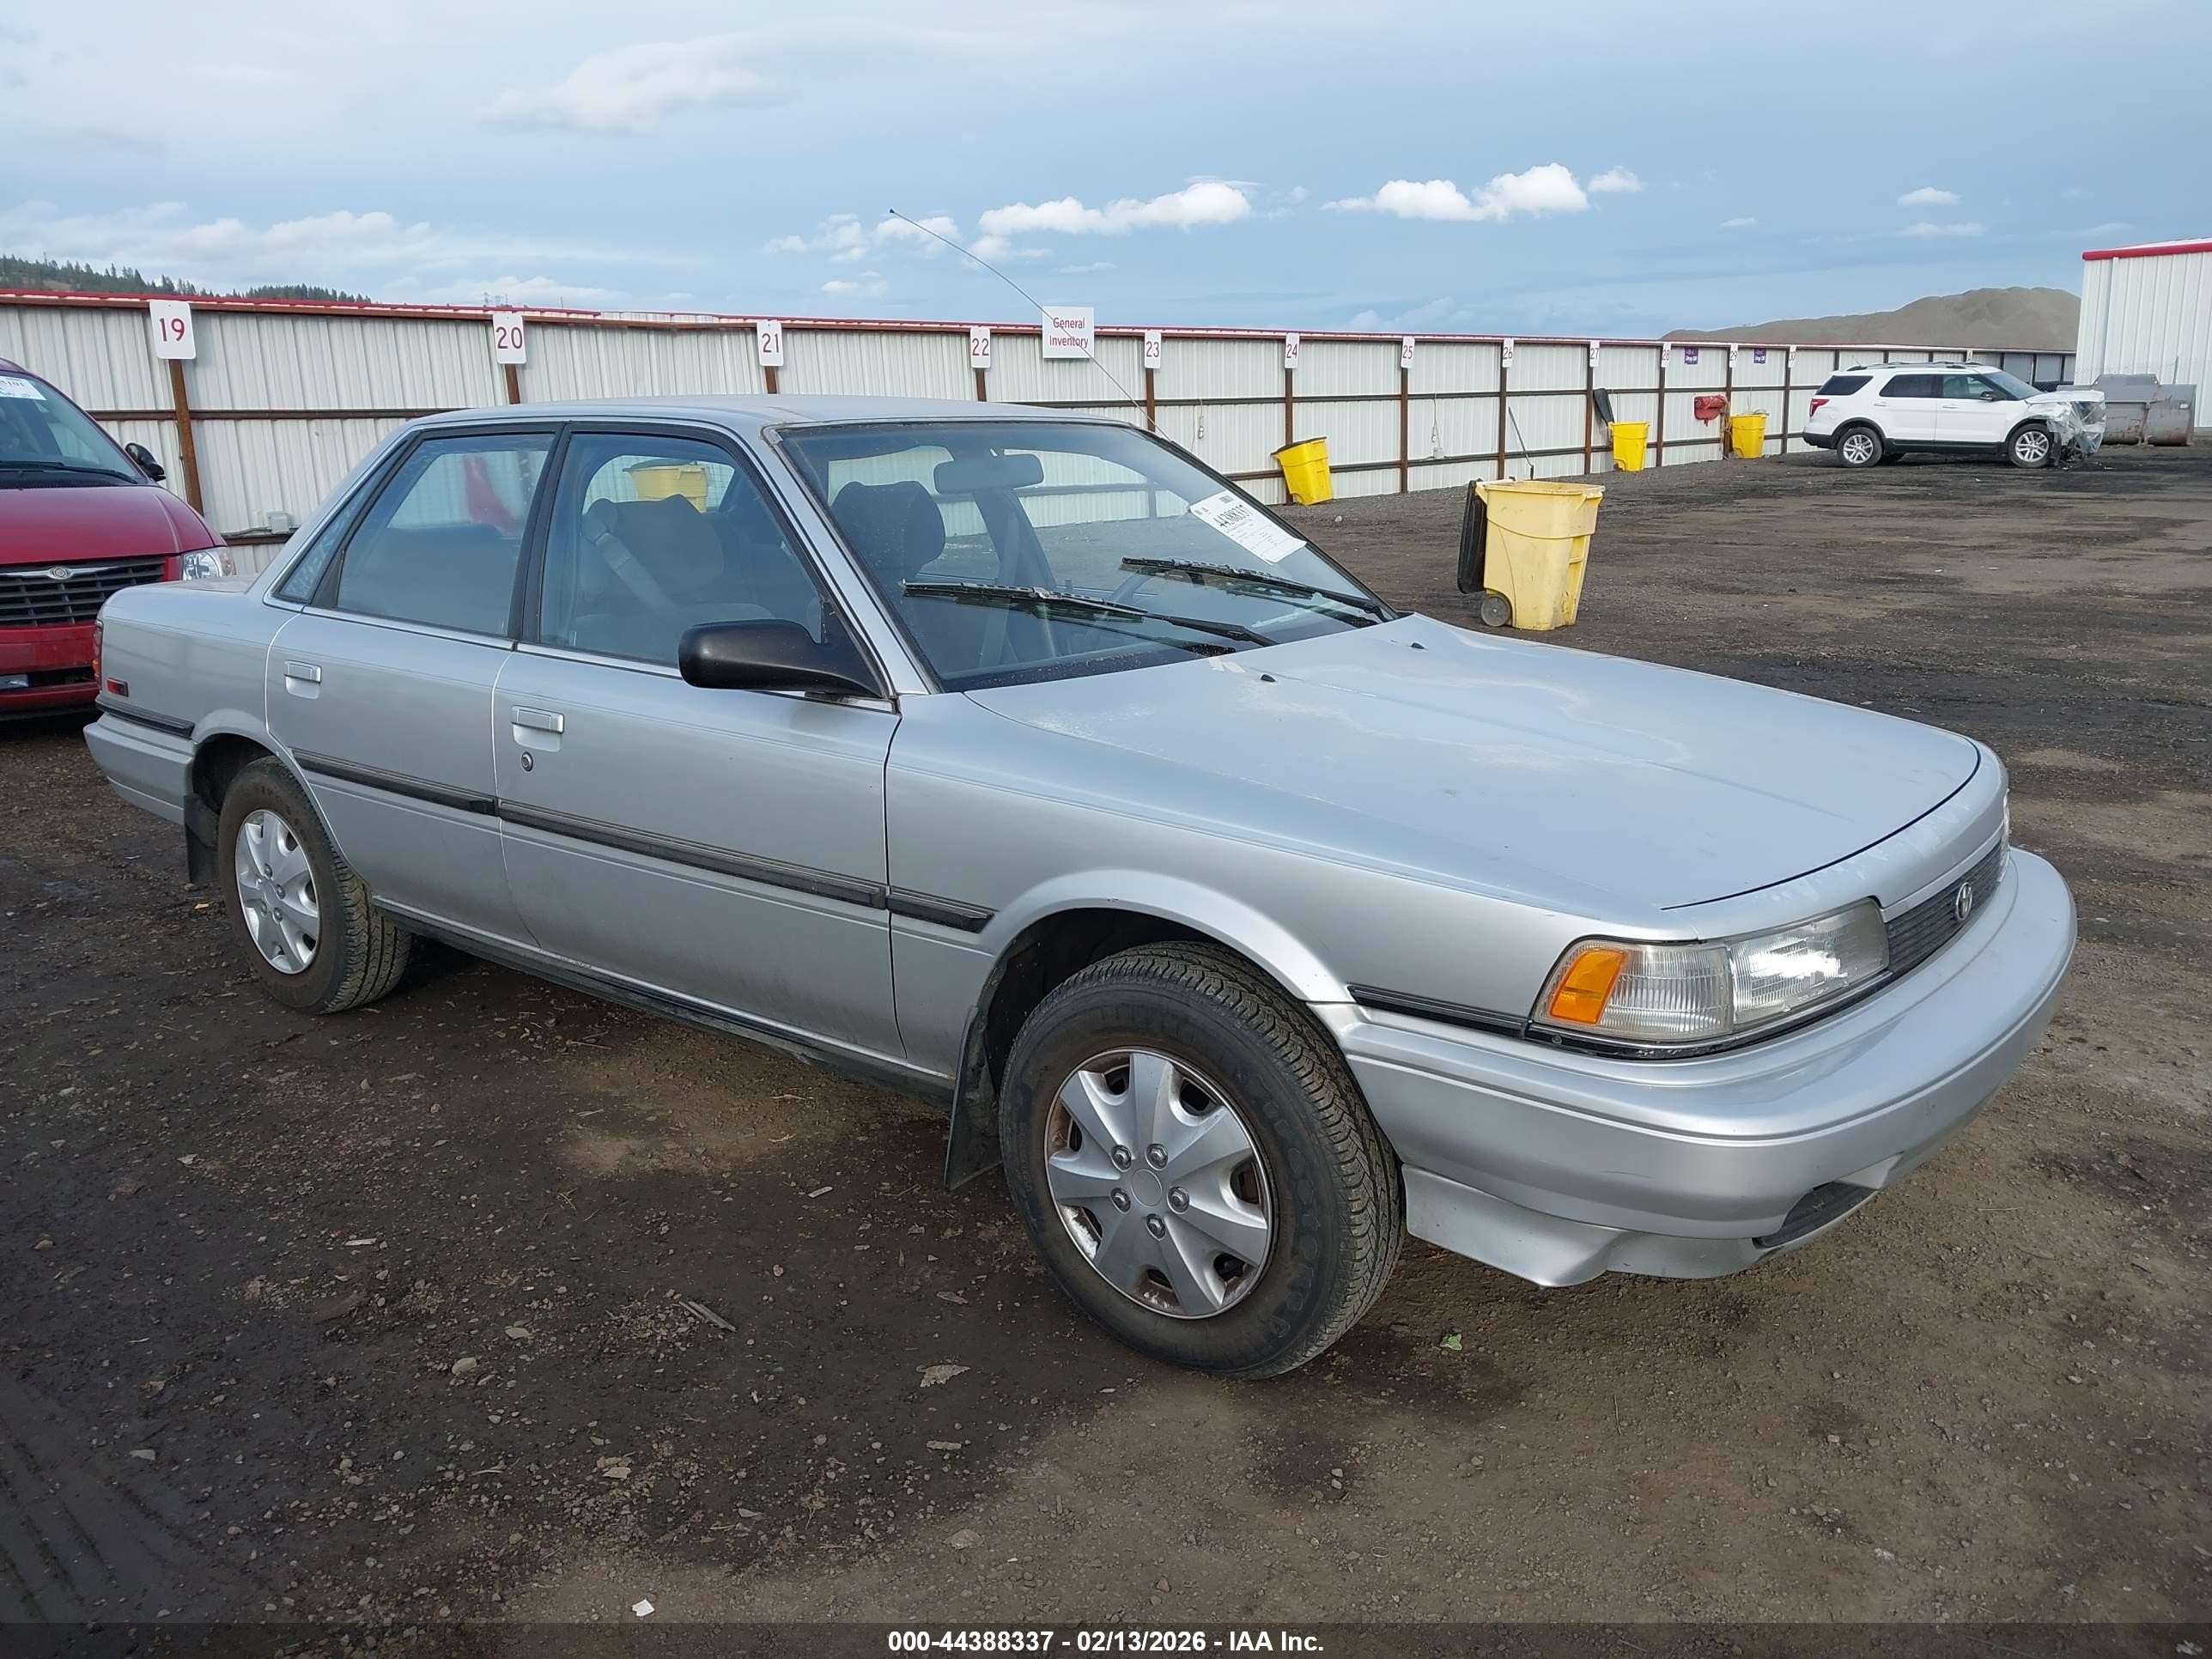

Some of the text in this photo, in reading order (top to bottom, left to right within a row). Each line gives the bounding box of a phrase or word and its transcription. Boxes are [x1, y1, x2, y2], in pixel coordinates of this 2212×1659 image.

[159, 317, 185, 342] 19
[1053, 317, 1085, 329] General
[495, 326, 523, 349] 20
[762, 332, 780, 353] 21
[1049, 334, 1089, 349] Inventory
[972, 337, 989, 356] 22
[1146, 341, 1159, 358] 23
[1286, 343, 1297, 359] 24
[1402, 344, 1413, 360] 25
[1503, 346, 1513, 360] 26
[1590, 347, 1600, 360] 27
[1212, 504, 1254, 528] 44388337
